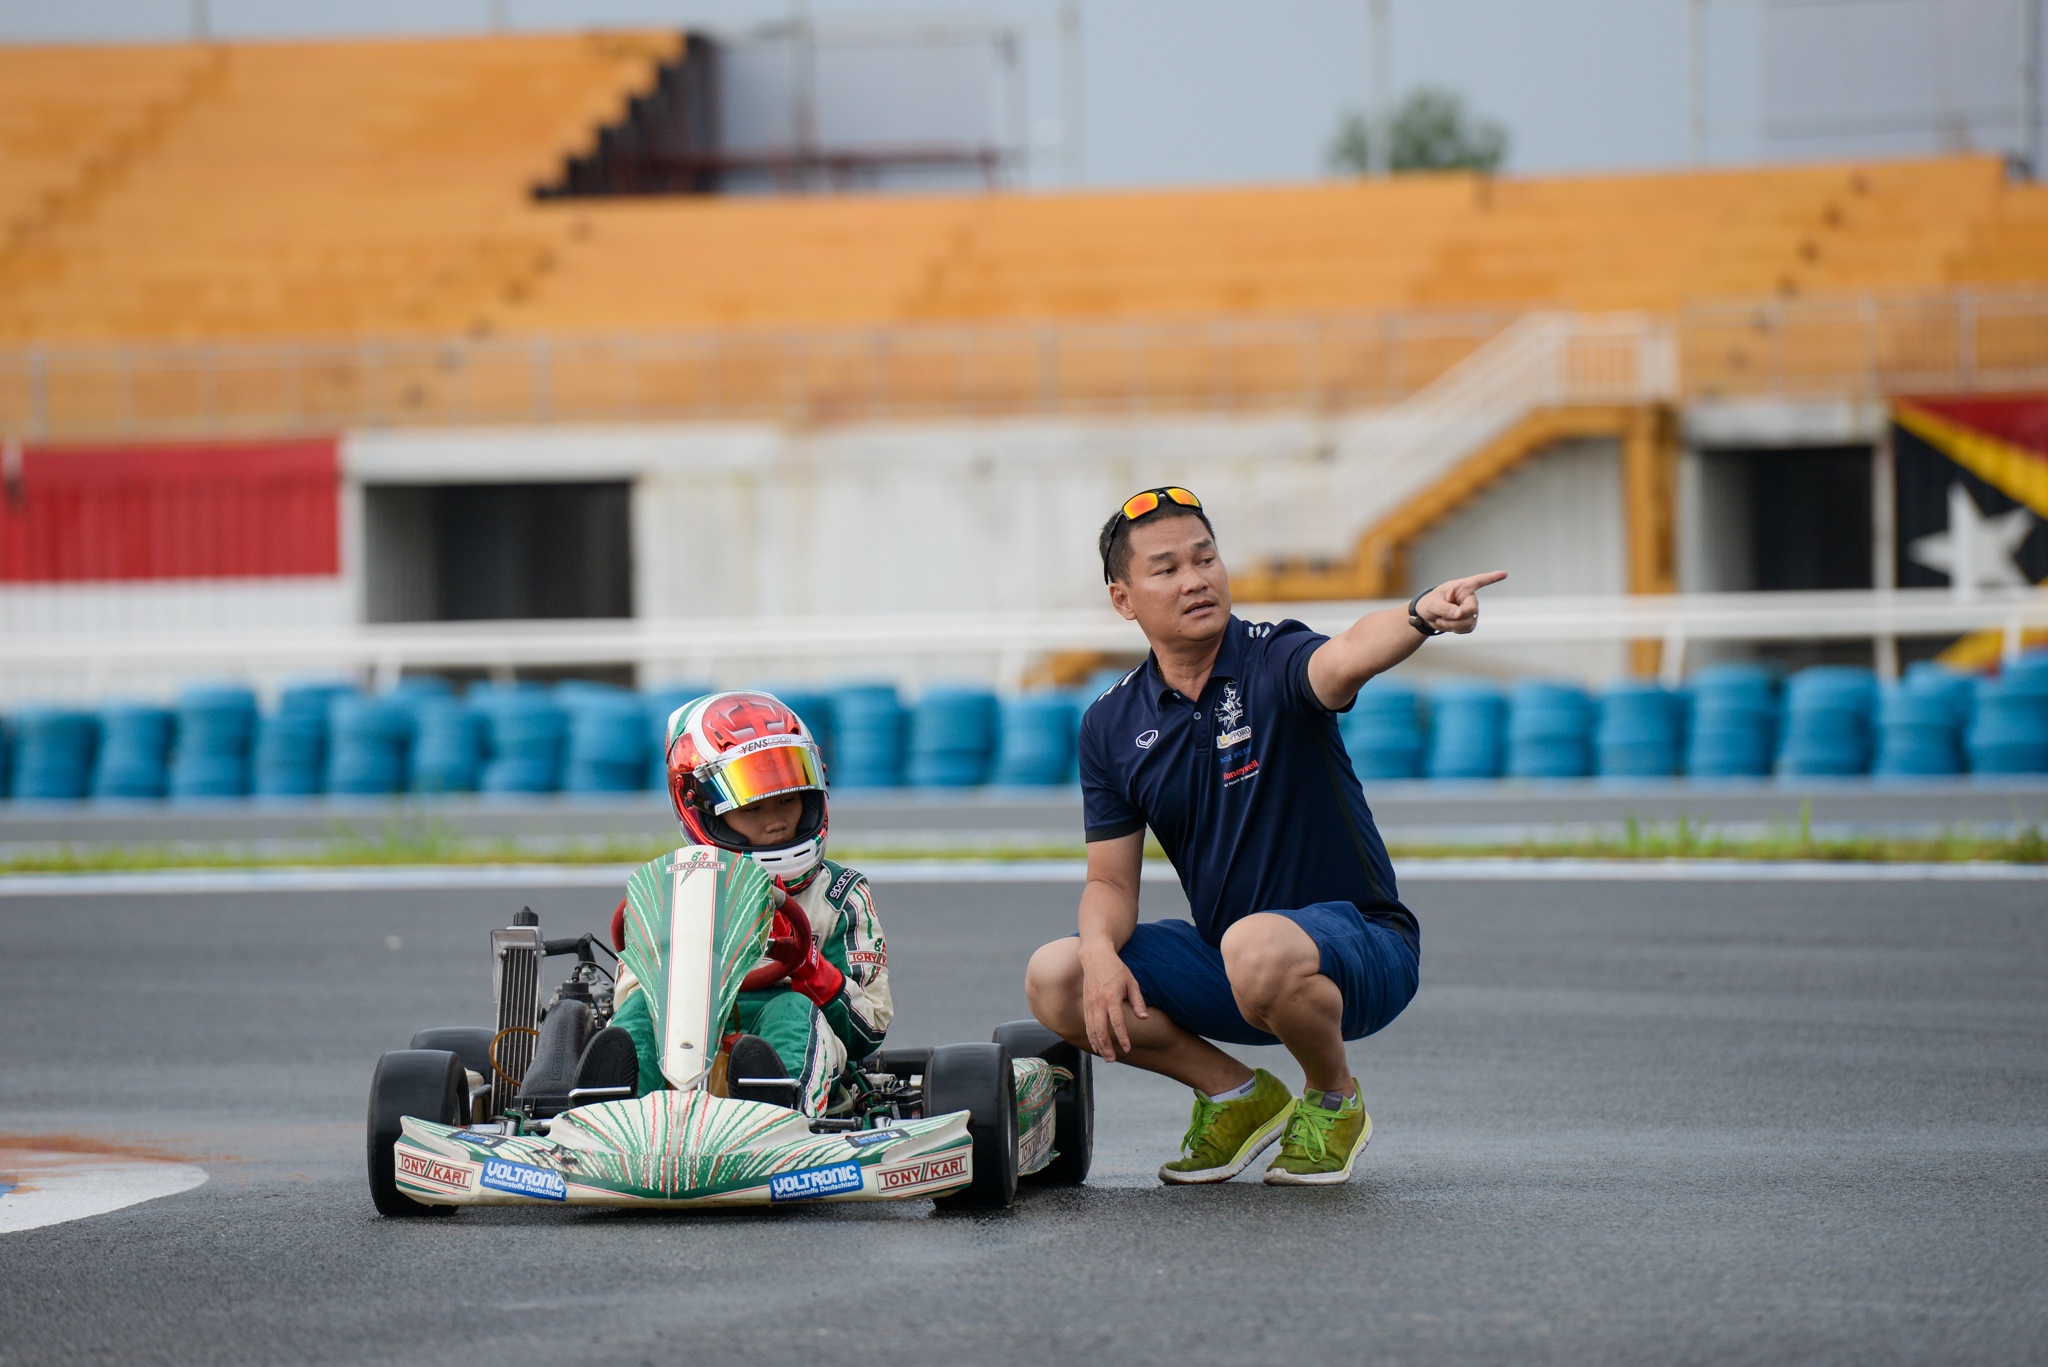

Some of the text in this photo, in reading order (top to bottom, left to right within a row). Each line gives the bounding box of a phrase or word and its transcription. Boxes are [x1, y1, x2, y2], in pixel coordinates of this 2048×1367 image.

[829, 868, 856, 899] sparco
[851, 953, 877, 963] TONY
[854, 1131, 898, 1141] GoPro
[399, 1154, 471, 1185] TONY KART
[486, 1161, 564, 1191] VOLTRONIC
[773, 1164, 859, 1193] VOLTRONIC
[878, 1155, 966, 1187] TONY KART
[484, 1176, 563, 1198] Schmierstoffe Deutschland
[820, 1180, 859, 1193] Deutschland
